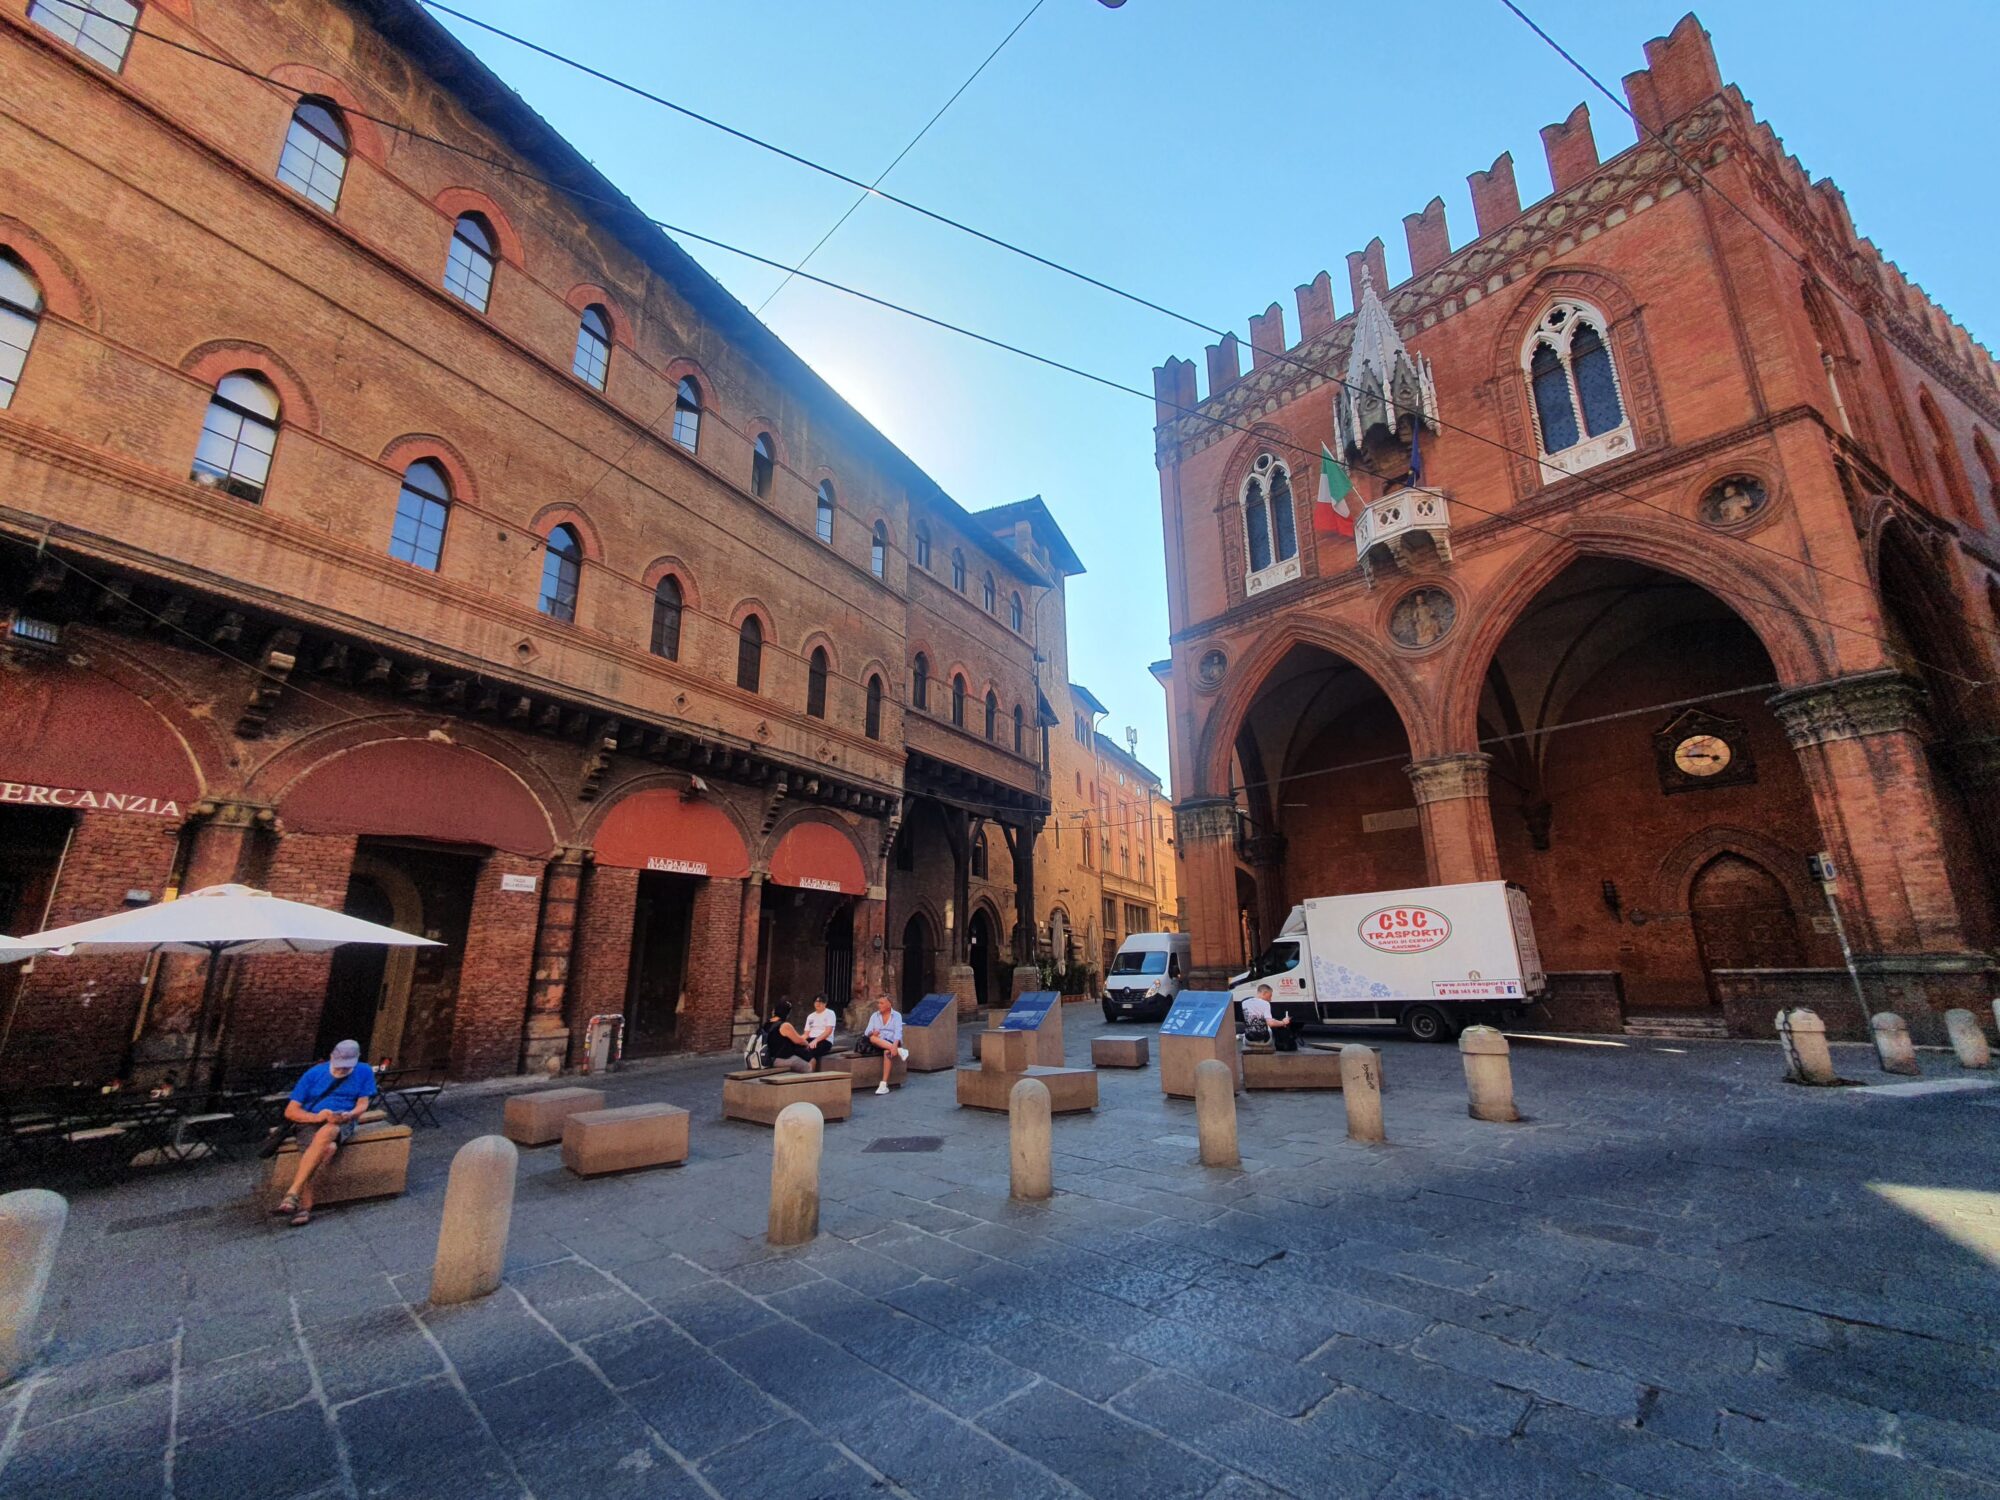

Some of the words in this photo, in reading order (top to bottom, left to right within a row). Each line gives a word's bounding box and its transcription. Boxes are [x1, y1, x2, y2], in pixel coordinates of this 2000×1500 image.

[0, 782, 180, 817] ERCANZIA
[1379, 910, 1427, 930] CSC
[1366, 928, 1444, 940] TRASPORTI
